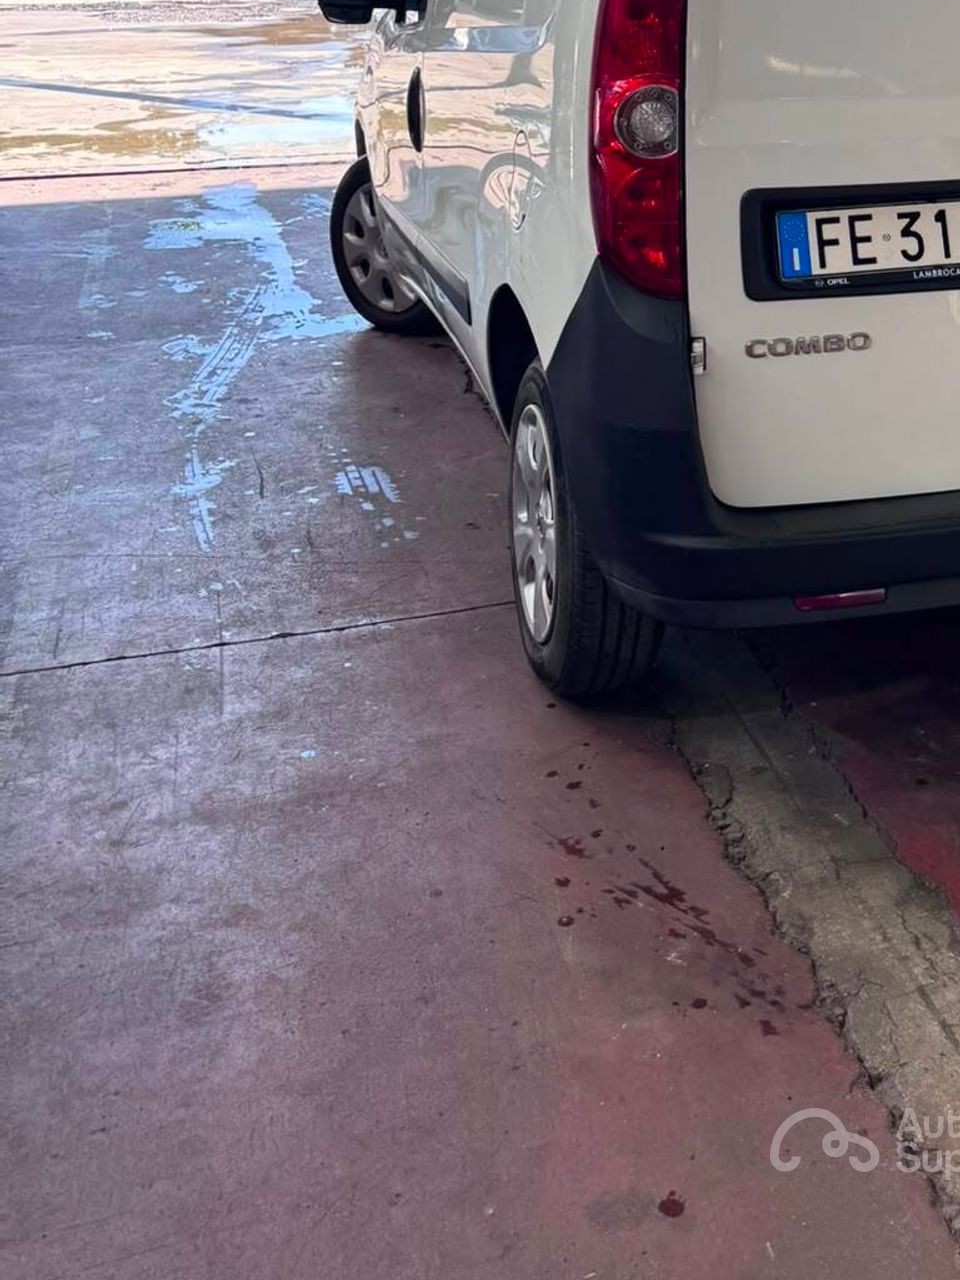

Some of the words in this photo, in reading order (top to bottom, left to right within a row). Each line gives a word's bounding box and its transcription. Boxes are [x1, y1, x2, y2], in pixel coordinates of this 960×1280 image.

[815, 214, 877, 269] FE
[827, 278, 850, 286] OPEL
[745, 332, 872, 358] COMBO
